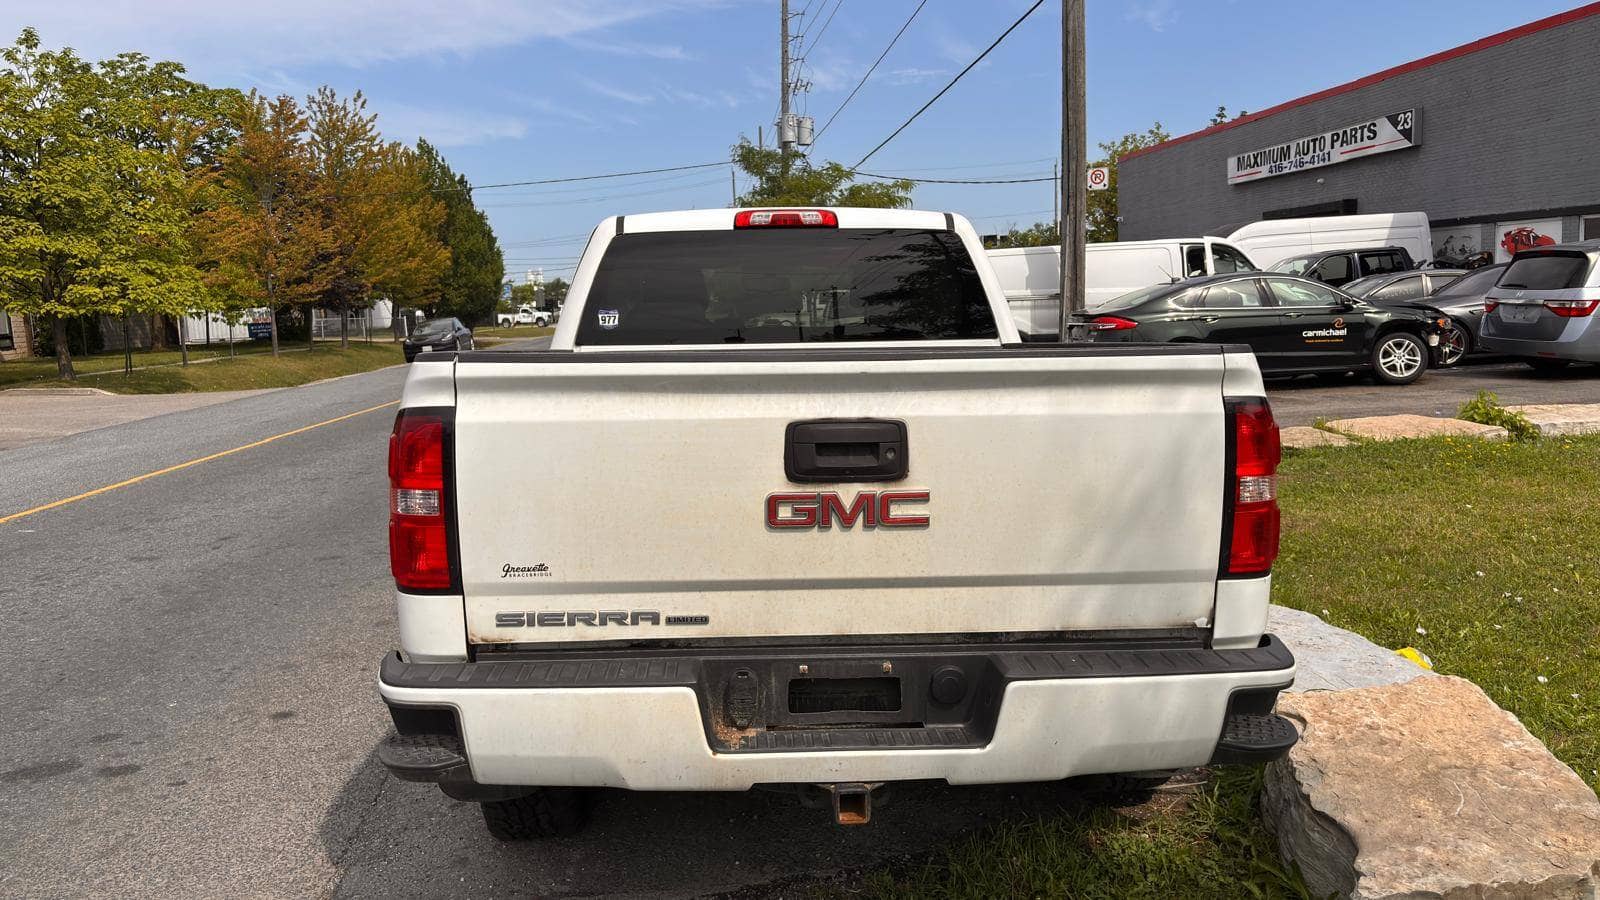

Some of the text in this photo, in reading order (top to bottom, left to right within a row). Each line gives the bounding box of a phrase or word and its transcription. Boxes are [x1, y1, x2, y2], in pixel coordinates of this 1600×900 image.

[1397, 112, 1412, 131] 23
[1237, 122, 1378, 172] MAXIMUM AUTO PARTS
[1268, 151, 1332, 175] 416-746-4141
[600, 315, 617, 325] 977
[1302, 328, 1347, 338] carmichael
[766, 489, 931, 530] GMC
[496, 609, 709, 628] SIERRA LIMITED
